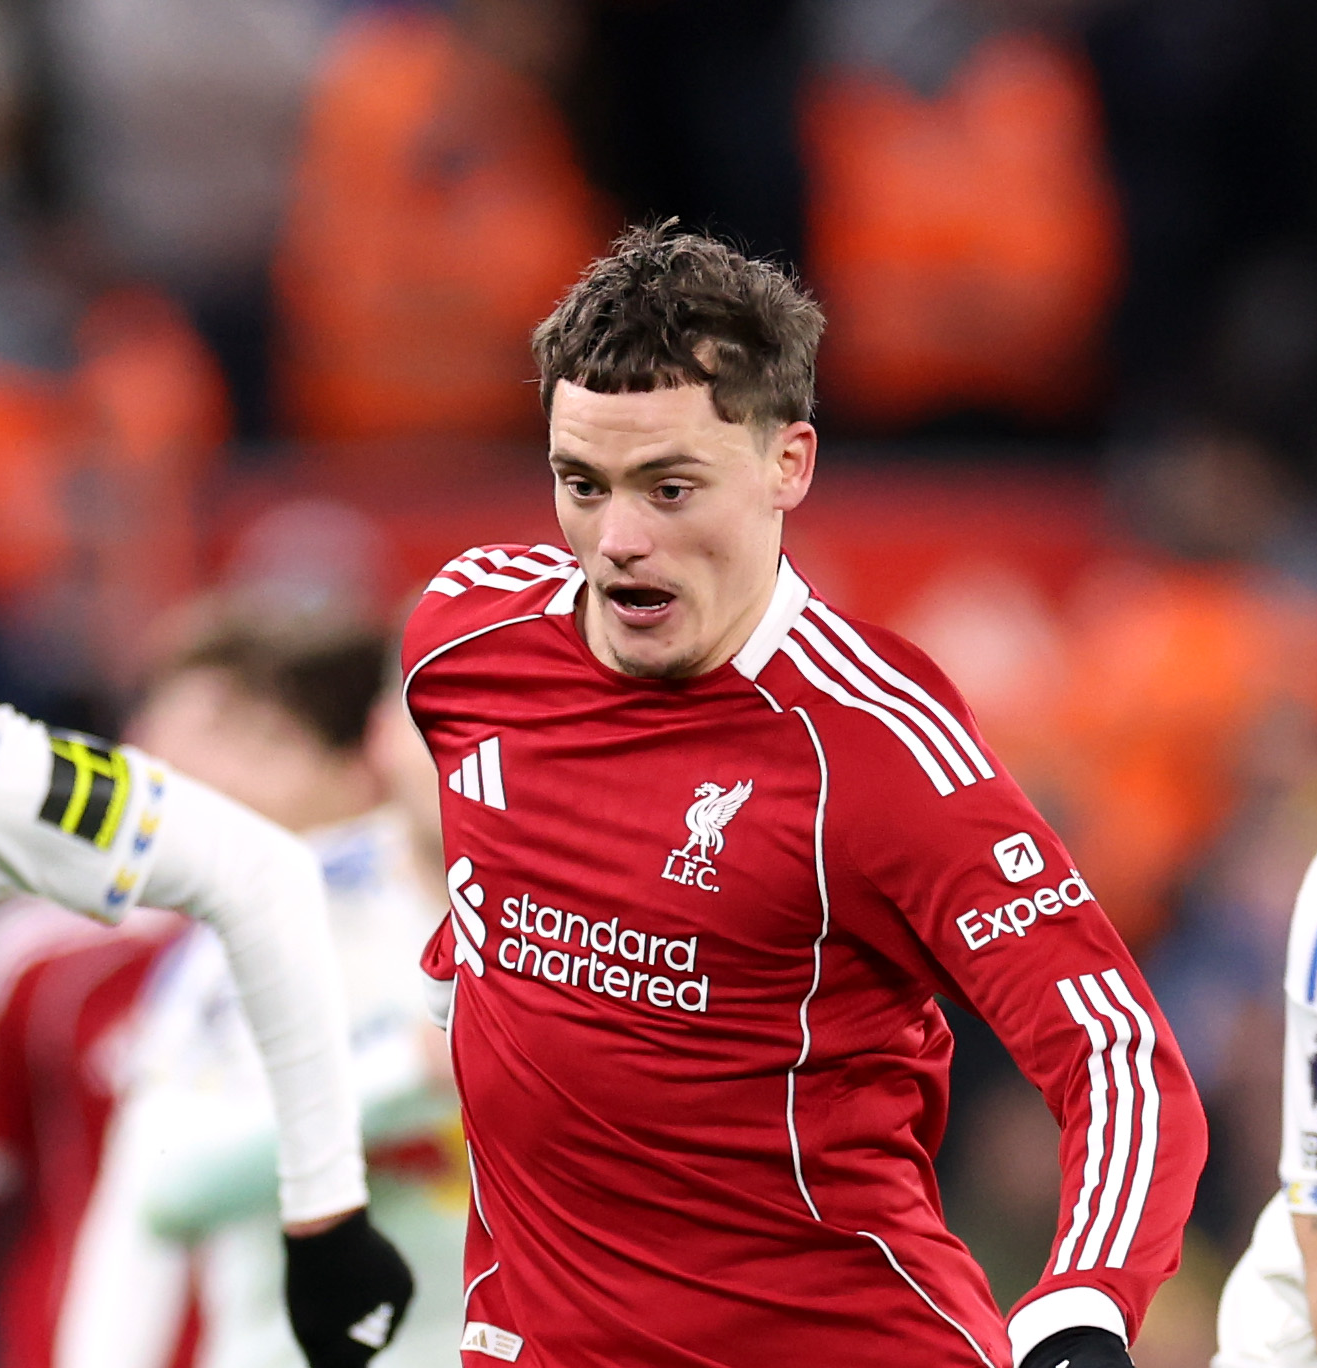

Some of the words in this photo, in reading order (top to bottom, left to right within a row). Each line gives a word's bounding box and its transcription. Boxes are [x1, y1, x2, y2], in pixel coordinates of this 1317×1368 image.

[661, 855, 720, 892] L.F.C.
[500, 893, 698, 972] standard
[498, 936, 709, 1012] chartered
